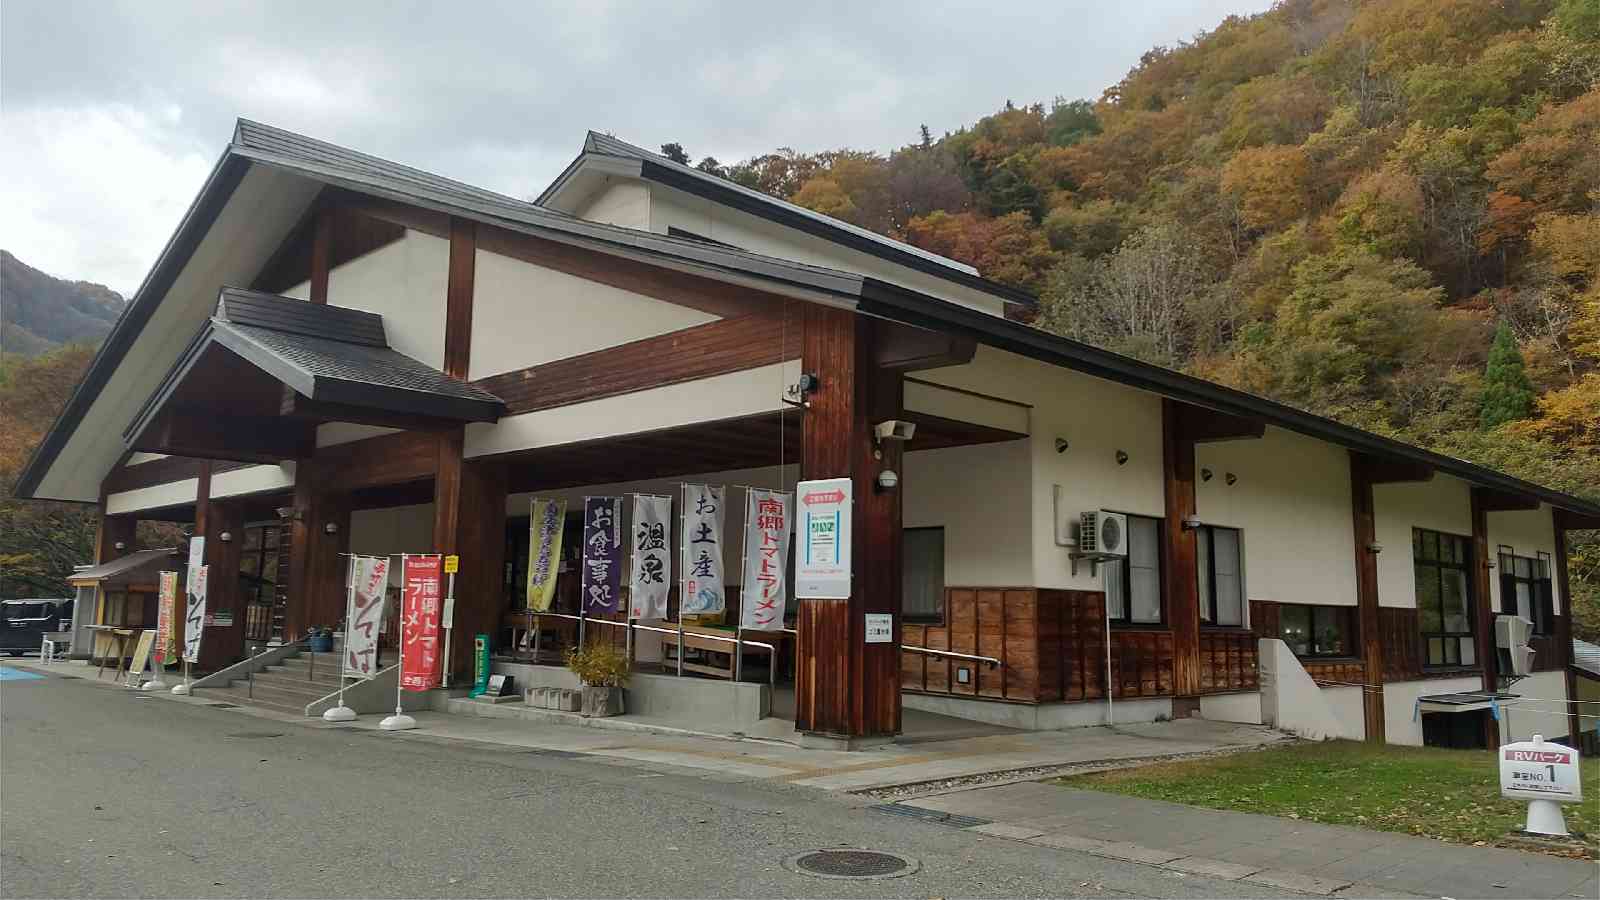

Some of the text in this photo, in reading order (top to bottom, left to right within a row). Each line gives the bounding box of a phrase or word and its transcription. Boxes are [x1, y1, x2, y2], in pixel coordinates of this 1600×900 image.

[587, 506, 612, 606] お食事処
[691, 494, 717, 578] お土産
[753, 498, 784, 625] 南郷トマトラーメン
[406, 578, 421, 645] ラーメン
